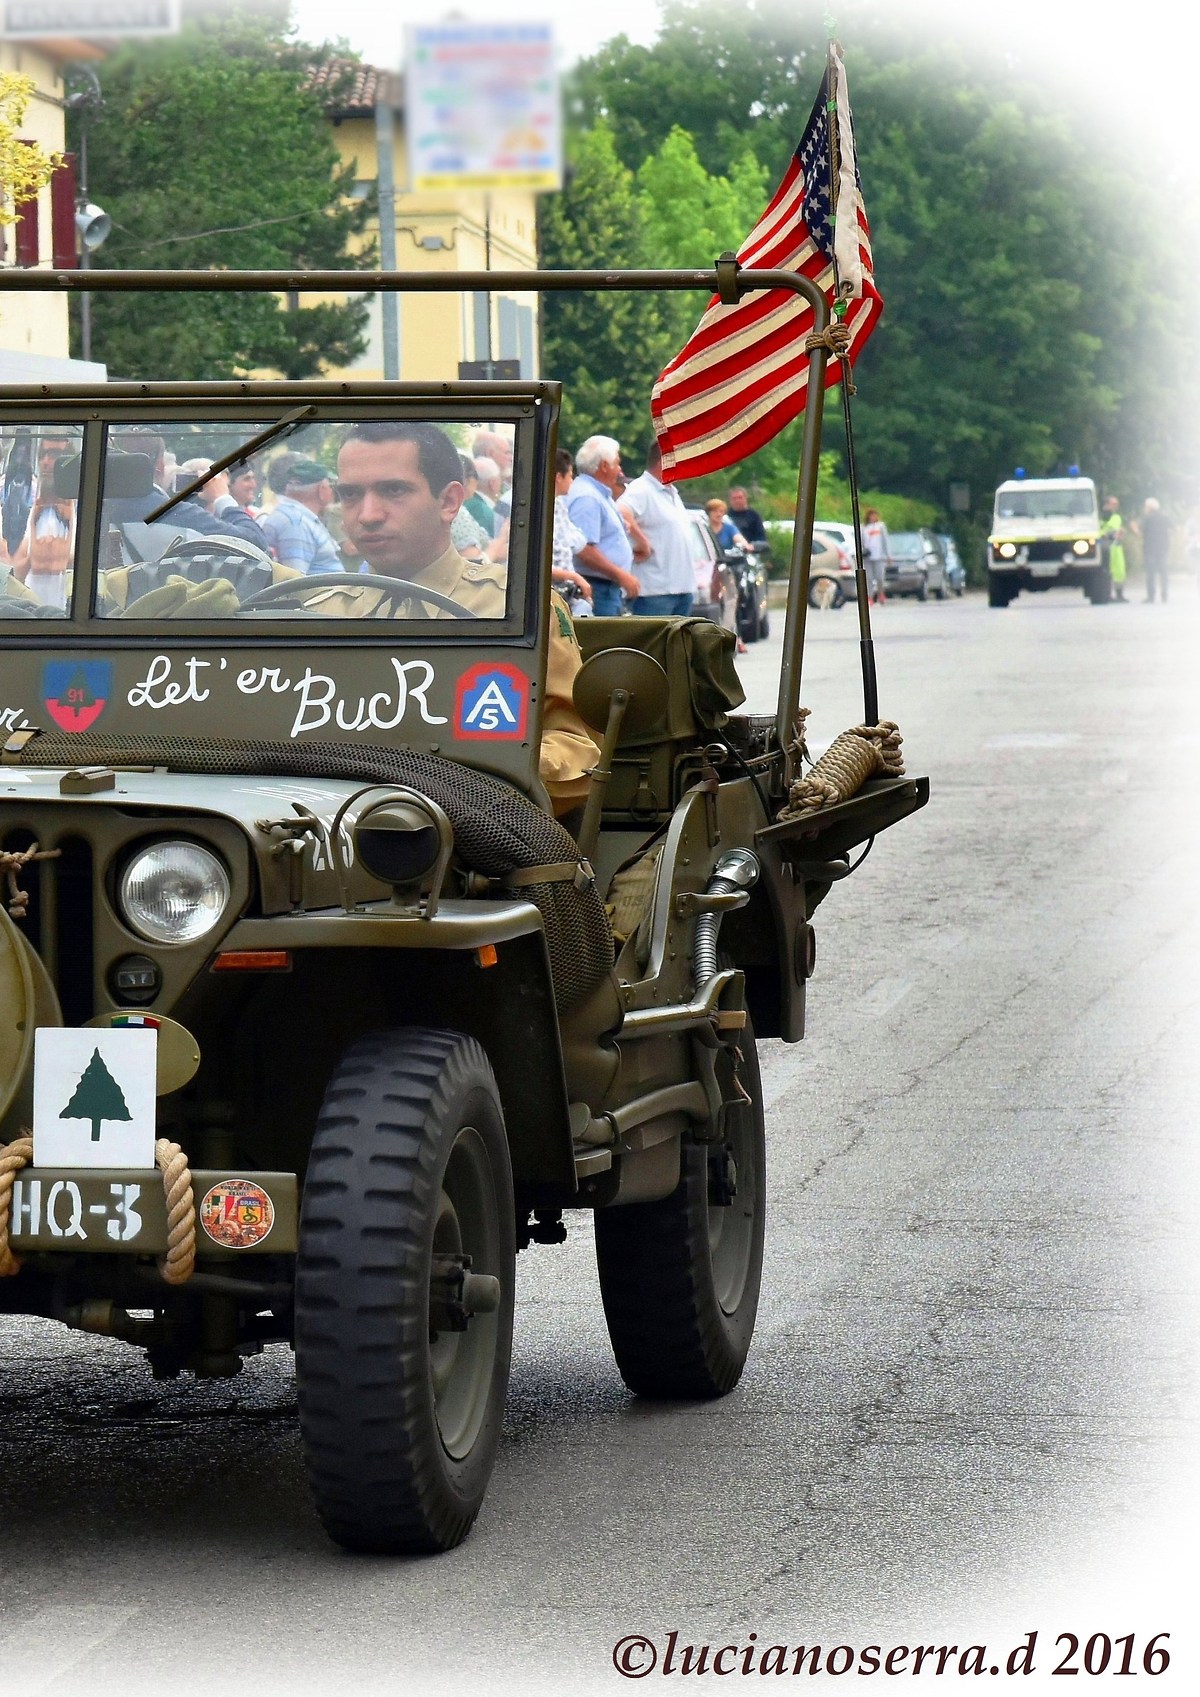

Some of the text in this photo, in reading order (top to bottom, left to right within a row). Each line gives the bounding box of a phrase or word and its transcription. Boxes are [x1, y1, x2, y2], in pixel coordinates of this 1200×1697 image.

[68, 687, 85, 703] 91
[465, 680, 516, 723] A
[478, 708, 499, 730] 5
[11, 1180, 142, 1240] HQ-3
